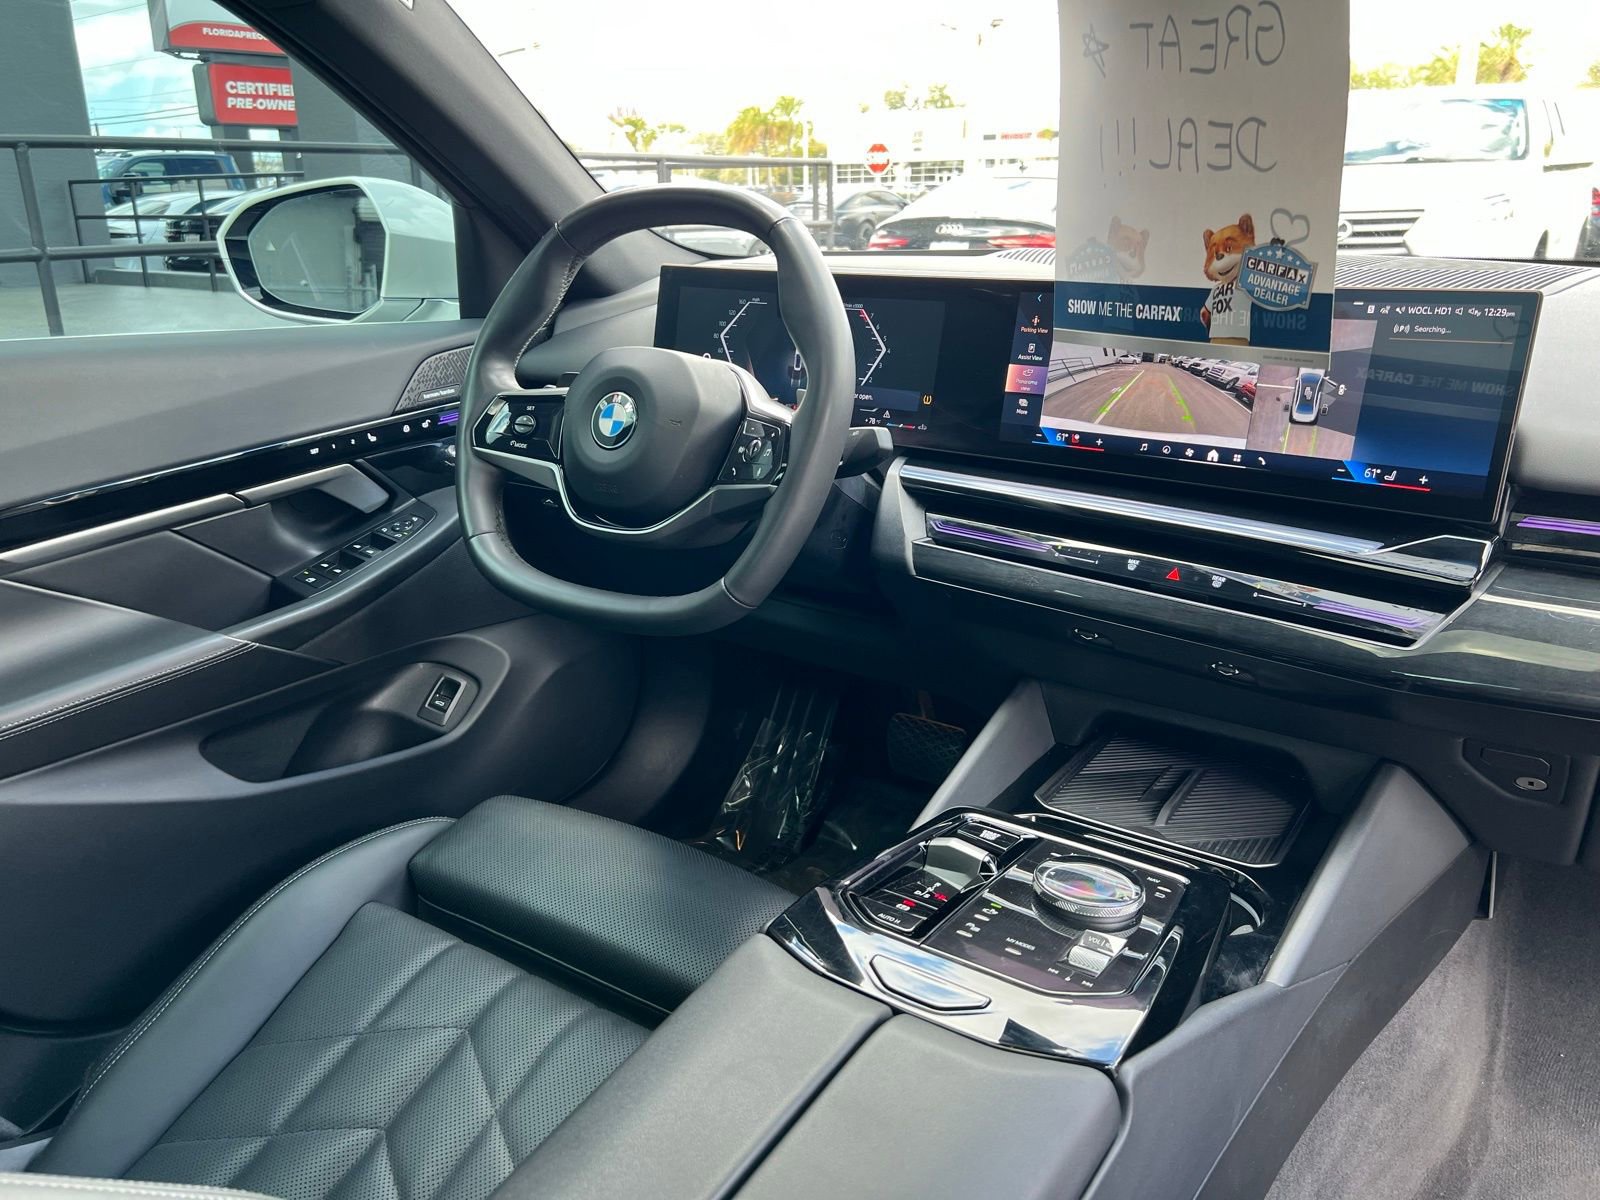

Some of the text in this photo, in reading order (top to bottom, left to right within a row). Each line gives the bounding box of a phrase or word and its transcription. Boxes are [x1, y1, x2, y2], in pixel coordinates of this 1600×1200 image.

[202, 27, 268, 41] FLORIDAPREO
[227, 97, 296, 111] PRE-OWNE
[1247, 257, 1308, 284] CARFAX
[1213, 281, 1234, 299] CAR
[1247, 273, 1301, 296] ADVANTAGE
[1253, 287, 1289, 306] DEALER
[1067, 299, 1097, 315] SHOW
[1098, 301, 1113, 317] ME
[1114, 301, 1134, 319] THE
[1135, 303, 1183, 322] CARFAX
[1211, 297, 1233, 316] FOX
[1408, 306, 1452, 315] WOCL HD1
[1020, 326, 1037, 334] Parking
[1017, 353, 1032, 361] Assist
[600, 394, 634, 413] BMW
